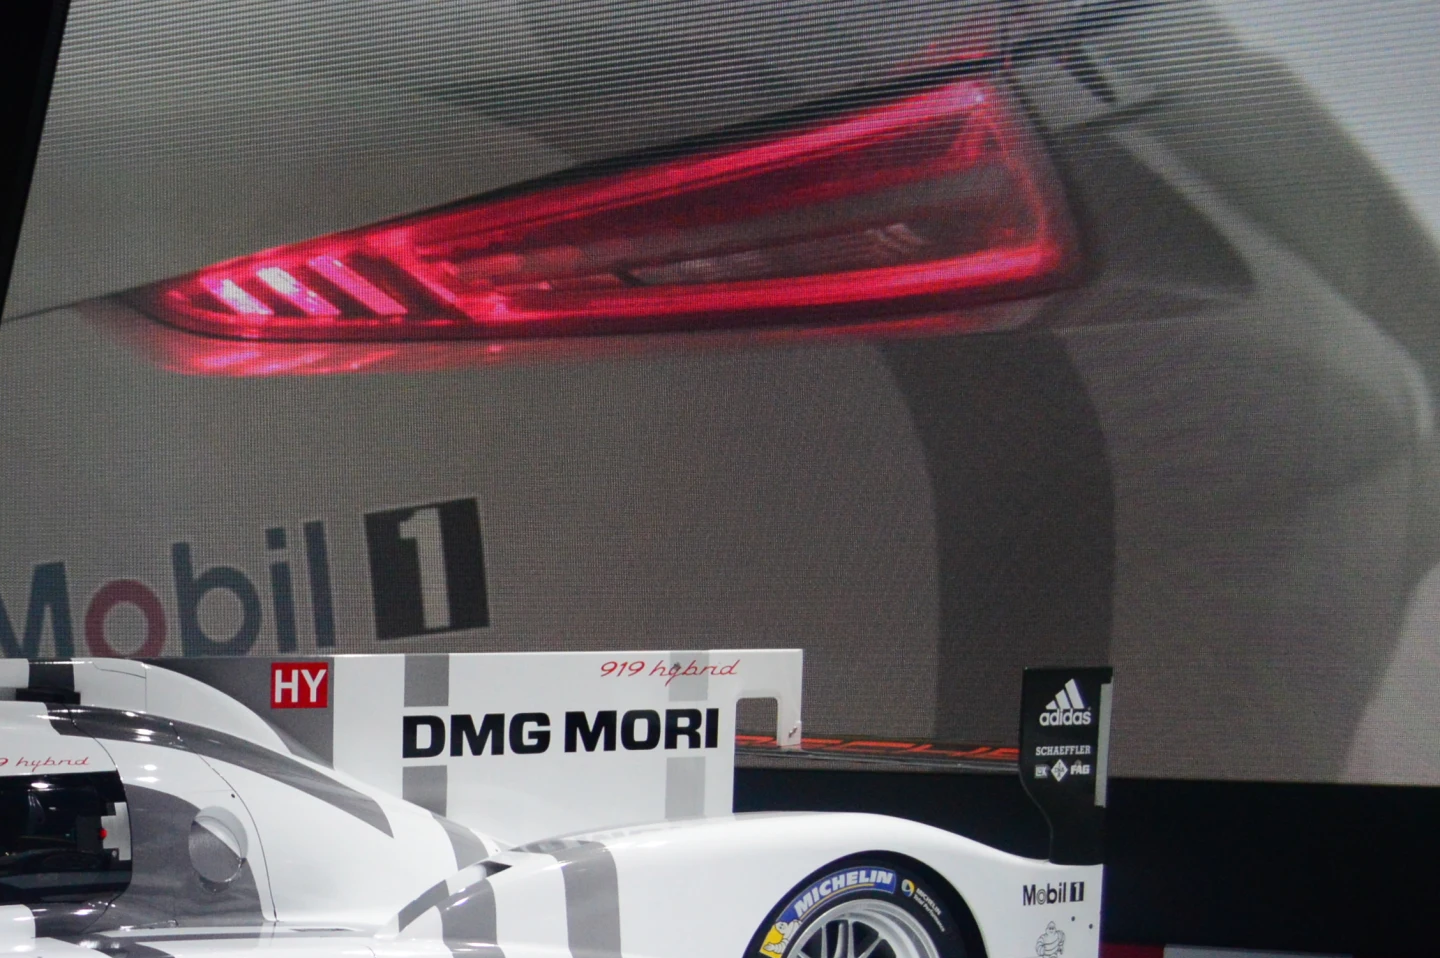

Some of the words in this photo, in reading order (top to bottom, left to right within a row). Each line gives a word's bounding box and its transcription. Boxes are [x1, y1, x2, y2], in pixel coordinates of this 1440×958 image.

[274, 669, 327, 703] HY
[601, 660, 645, 677] 919
[648, 659, 740, 687] hybrid
[1039, 708, 1092, 726] adidas
[402, 712, 552, 759] DMG
[564, 708, 720, 753] MORI
[1035, 745, 1091, 756] SCHAEFFLER
[15, 756, 90, 773] hybrid
[793, 869, 894, 917] MICHELIN
[1022, 881, 1067, 906] Mobil
